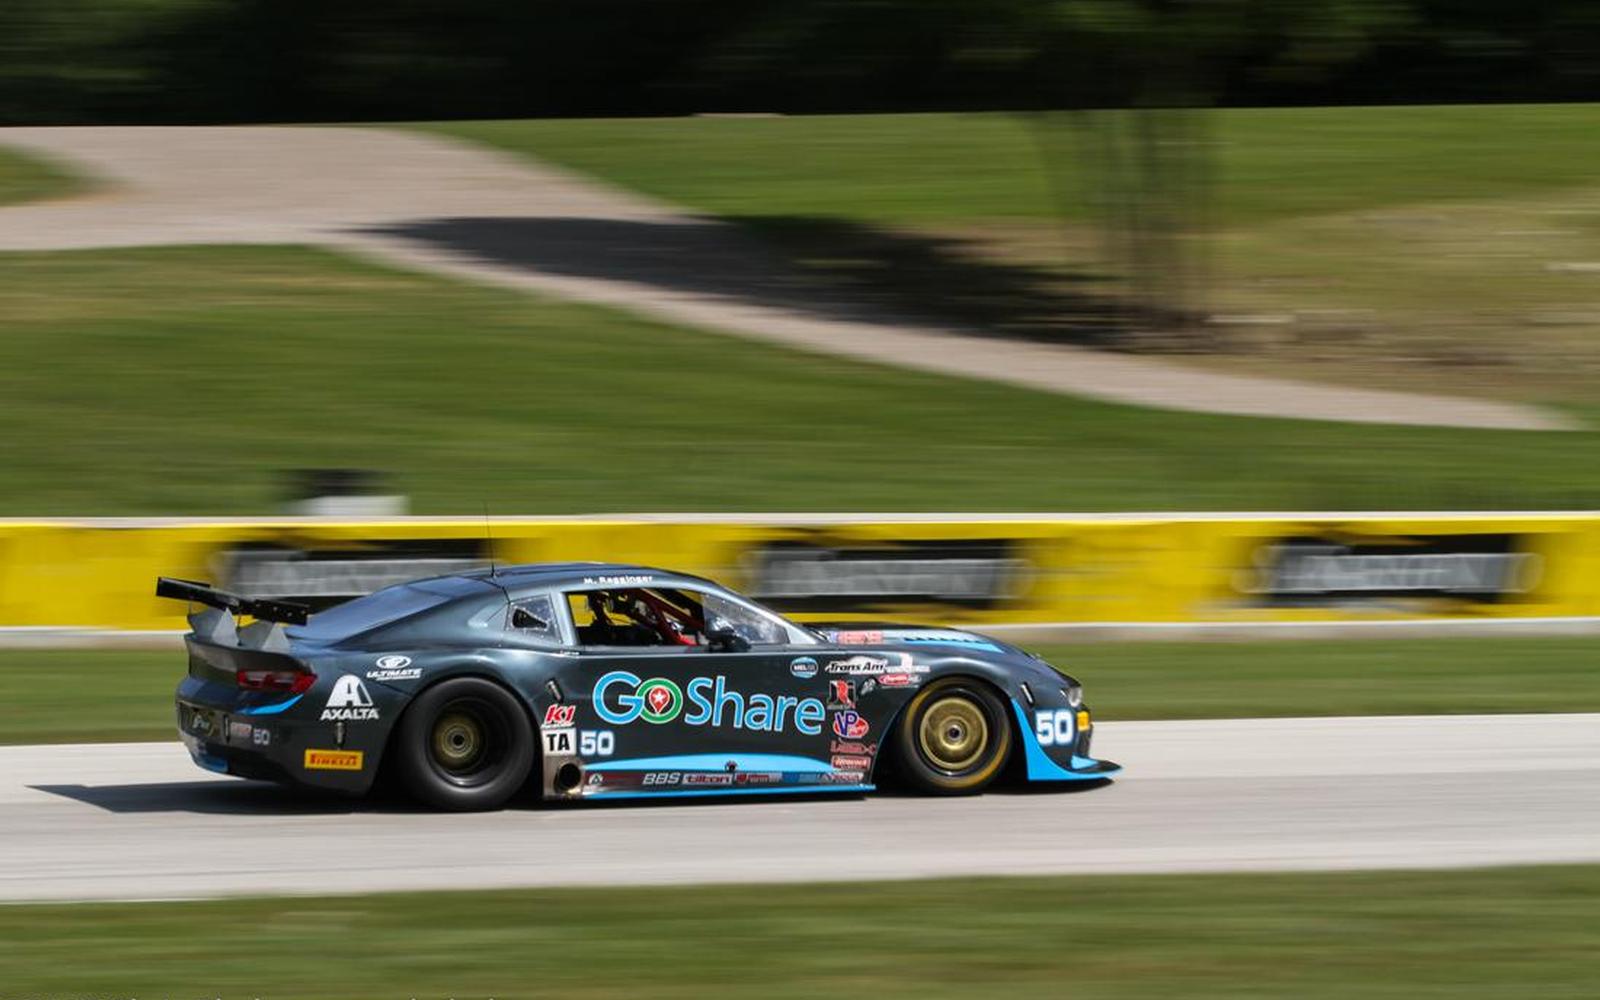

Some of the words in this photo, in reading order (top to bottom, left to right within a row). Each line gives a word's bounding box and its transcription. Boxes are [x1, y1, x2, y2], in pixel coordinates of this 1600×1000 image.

[366, 668, 423, 678] ULTIMATE
[829, 661, 861, 673] Trans
[863, 661, 884, 673] Am
[320, 707, 380, 721] AXALTA
[834, 710, 860, 736] VP
[1035, 709, 1074, 746] 50
[253, 728, 270, 746] 50
[546, 733, 570, 752] TA
[580, 730, 615, 756] 50
[309, 754, 358, 766] PIRELLI
[643, 772, 681, 785] BBS
